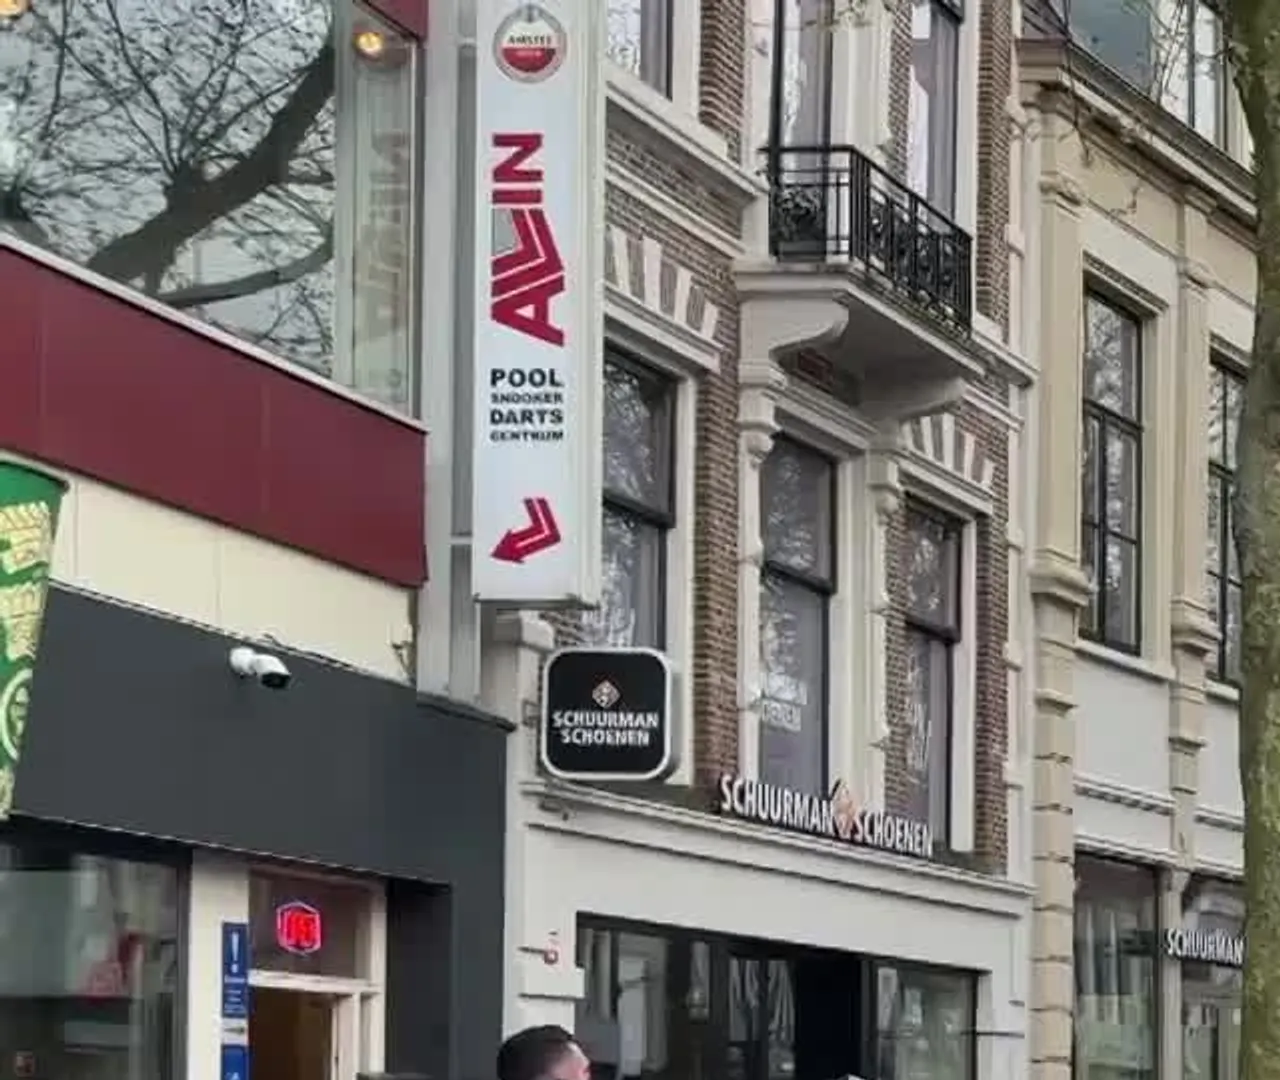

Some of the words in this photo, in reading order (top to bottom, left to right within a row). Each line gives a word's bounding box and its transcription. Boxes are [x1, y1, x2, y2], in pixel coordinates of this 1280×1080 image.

[490, 368, 565, 388] POOL
[491, 393, 564, 404] SNOOKER
[490, 408, 565, 426] DARTS
[490, 429, 565, 442] CENTRUM
[552, 710, 659, 729] SCHUURMAN
[560, 727, 650, 746] SCHOENEN
[720, 773, 834, 837] SCHUURMAN
[852, 807, 934, 858] SCHOENEN
[1167, 928, 1244, 965] SCHUURMAN
